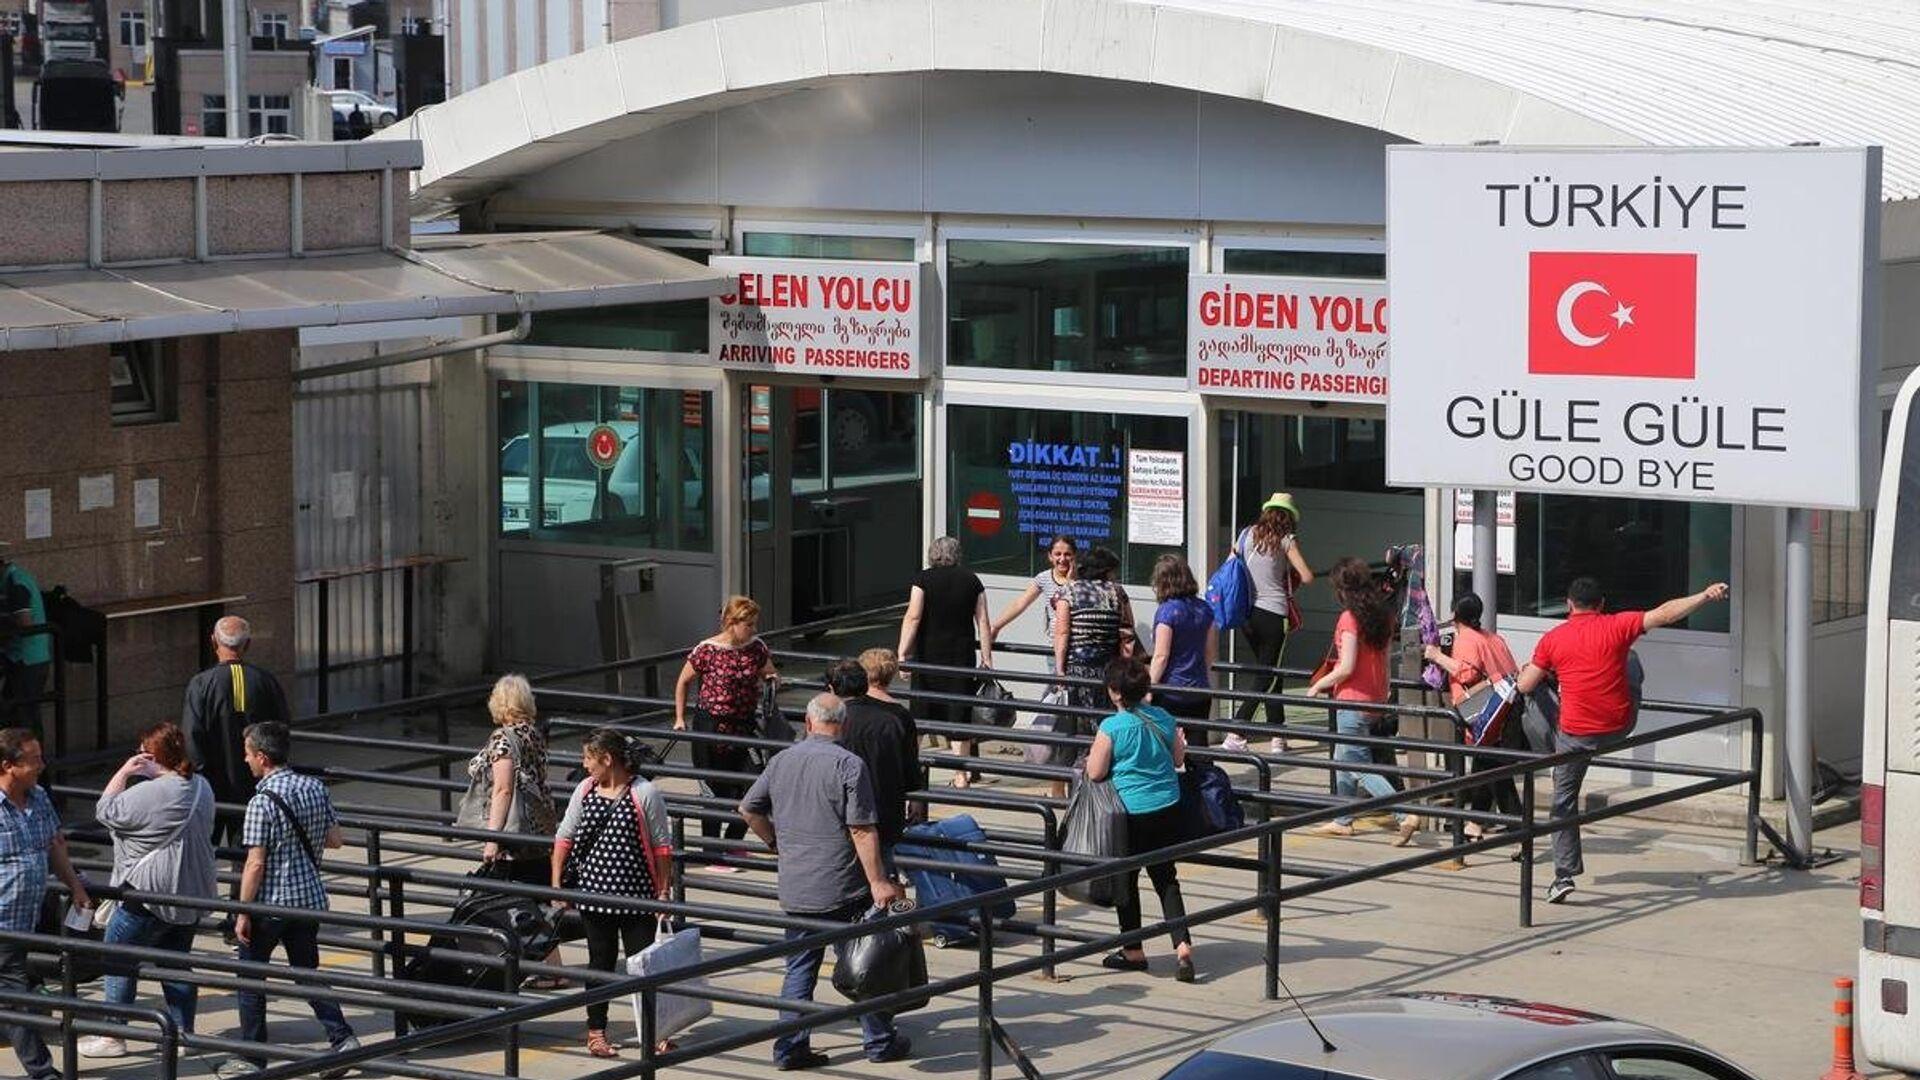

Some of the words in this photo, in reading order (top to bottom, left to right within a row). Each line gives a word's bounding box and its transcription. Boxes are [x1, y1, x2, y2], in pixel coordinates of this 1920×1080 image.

[1486, 176, 1747, 230] TÜRKİYE
[818, 276, 911, 313] YOLCU
[1200, 284, 1298, 330] GİDEN
[1310, 295, 1387, 334] YOLC
[719, 344, 795, 364] ARRIVING
[805, 348, 910, 371] PASSENGERS
[1199, 367, 1295, 390] DEPARTING
[1301, 373, 1387, 395] PASSENG
[1446, 390, 1601, 443] GÜLE
[1623, 396, 1787, 452] GÜLE
[1509, 453, 1624, 485] GOOD
[1640, 459, 1715, 491] BYE
